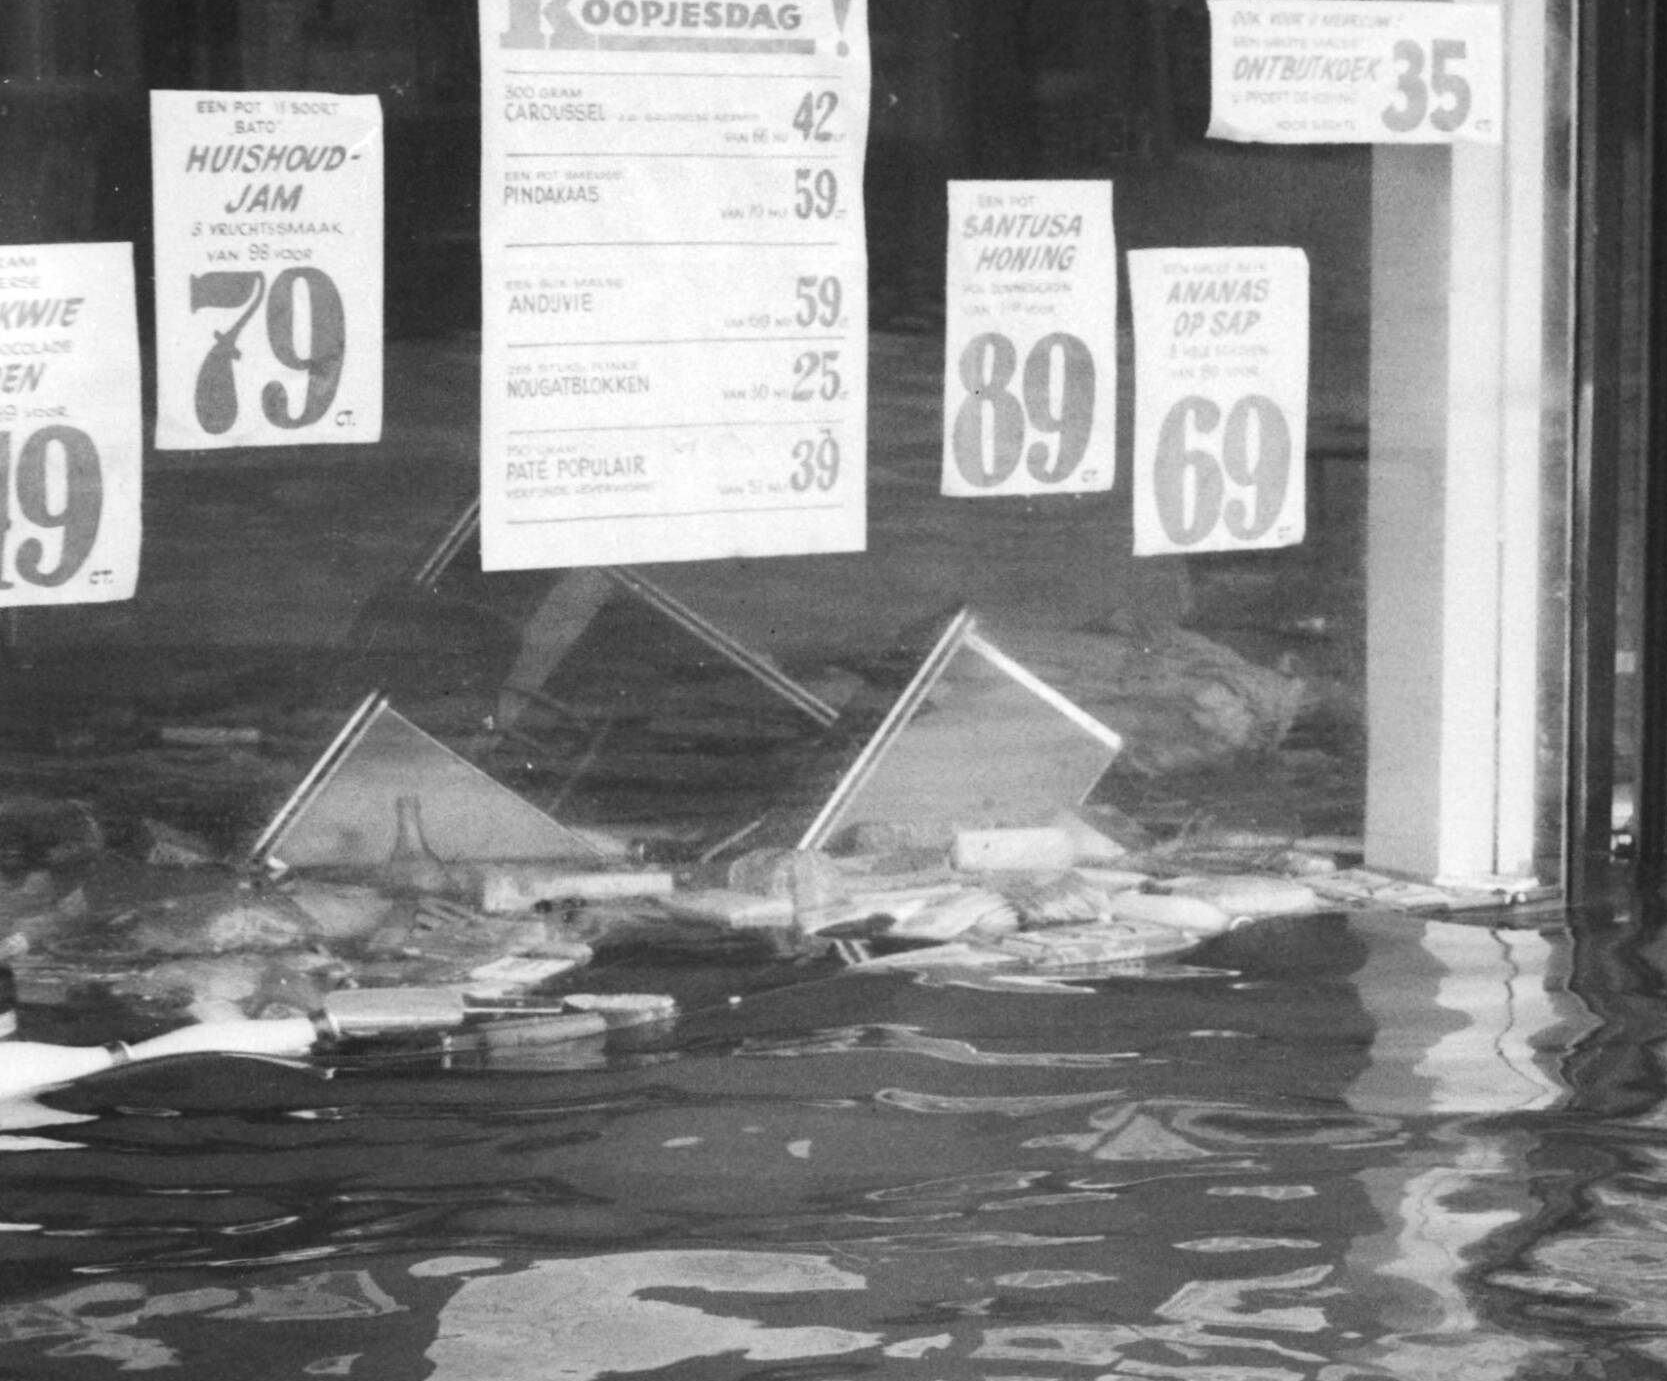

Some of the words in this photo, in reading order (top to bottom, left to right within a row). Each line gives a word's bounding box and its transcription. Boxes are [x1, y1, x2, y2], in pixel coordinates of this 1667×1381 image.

[1232, 55, 1383, 82] ONTBIJTKOEK
[538, 87, 583, 100] GRAM
[1381, 38, 1472, 133] 35
[196, 99, 228, 115] EEN
[234, 100, 261, 115] POT
[504, 101, 607, 123] CAROUSSEL
[793, 90, 840, 143] 42
[185, 143, 363, 174] HUISHOUD-
[224, 182, 304, 215] JAM
[503, 184, 601, 205] PINDAKAAS
[794, 168, 839, 220] 59
[962, 213, 1084, 239] SANTUSA
[206, 249, 240, 264] VAN
[976, 244, 1077, 273] HONING
[508, 292, 595, 315] ANDIJVIE
[795, 275, 843, 329] 59
[1165, 277, 1272, 306] ANANAS
[1172, 310, 1207, 339] OP
[1208, 310, 1263, 339] SAP
[190, 265, 346, 436] 79
[0, 362, 47, 394] EN
[506, 374, 651, 400] NOUGATBLOKKEN
[791, 350, 842, 401] 25
[952, 330, 1097, 489] 89
[556, 453, 648, 479] POPULAIR
[790, 436, 842, 493] 39
[1153, 393, 1293, 547] 69
[0, 423, 104, 590] 9
